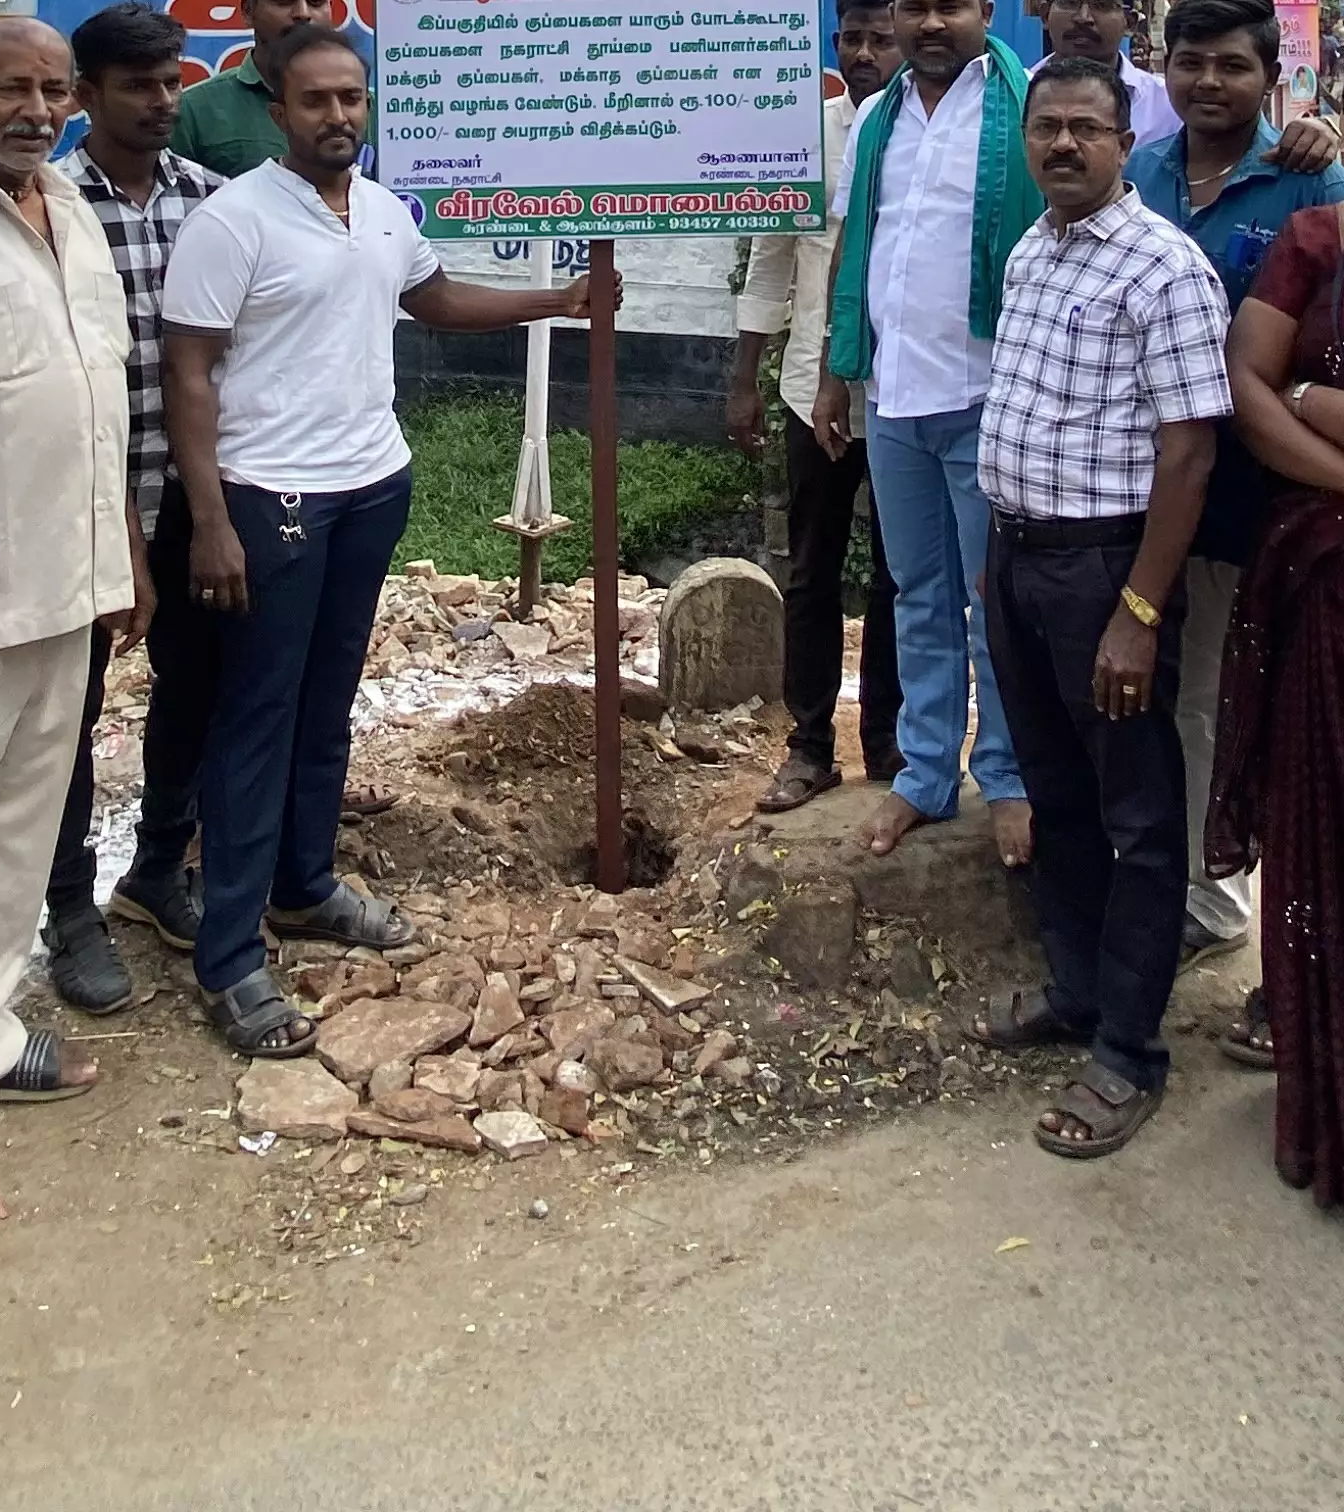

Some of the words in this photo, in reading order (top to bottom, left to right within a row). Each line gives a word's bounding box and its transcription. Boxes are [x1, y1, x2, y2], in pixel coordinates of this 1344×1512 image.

[417, 12, 519, 34] இப்பகுதியில்
[525, 12, 622, 33] குப்பைகளை
[629, 10, 684, 30] யாரும்
[385, 43, 483, 62] குப்பைகளை
[500, 40, 570, 59] நகராட்சி
[587, 37, 652, 60] தூய்மை
[669, 35, 812, 53] பணியாளர்களிடம்
[386, 69, 441, 88] மக்கும்
[560, 66, 621, 85] மக்காத
[636, 64, 719, 85] குப்பைகள்
[733, 67, 762, 80] என
[776, 63, 812, 83] தரம்
[386, 97, 444, 118] பிரித்து
[450, 96, 509, 116] வழங்க
[514, 93, 596, 113] வேண்டும்.
[604, 92, 674, 113] மீறினால்
[753, 90, 797, 110] முதல்
[455, 127, 497, 142] வரை
[502, 121, 574, 141] அபராதம்
[411, 154, 483, 172] தலைவர்
[697, 148, 810, 166] ஆணையாளர்
[393, 173, 449, 187] சுரண்டை
[452, 172, 502, 187] நகராட்சி
[699, 167, 755, 180] சுரண்டை
[758, 167, 808, 181] நகராட்சி
[436, 189, 585, 224] வீரவேல்
[591, 184, 811, 216] மொபைல்ஸ்
[462, 219, 536, 234] சுரண்டை
[539, 220, 553, 233] &
[556, 216, 656, 233] ஆலங்குளம்
[669, 217, 722, 230] 93457
[726, 215, 780, 229] 40330
